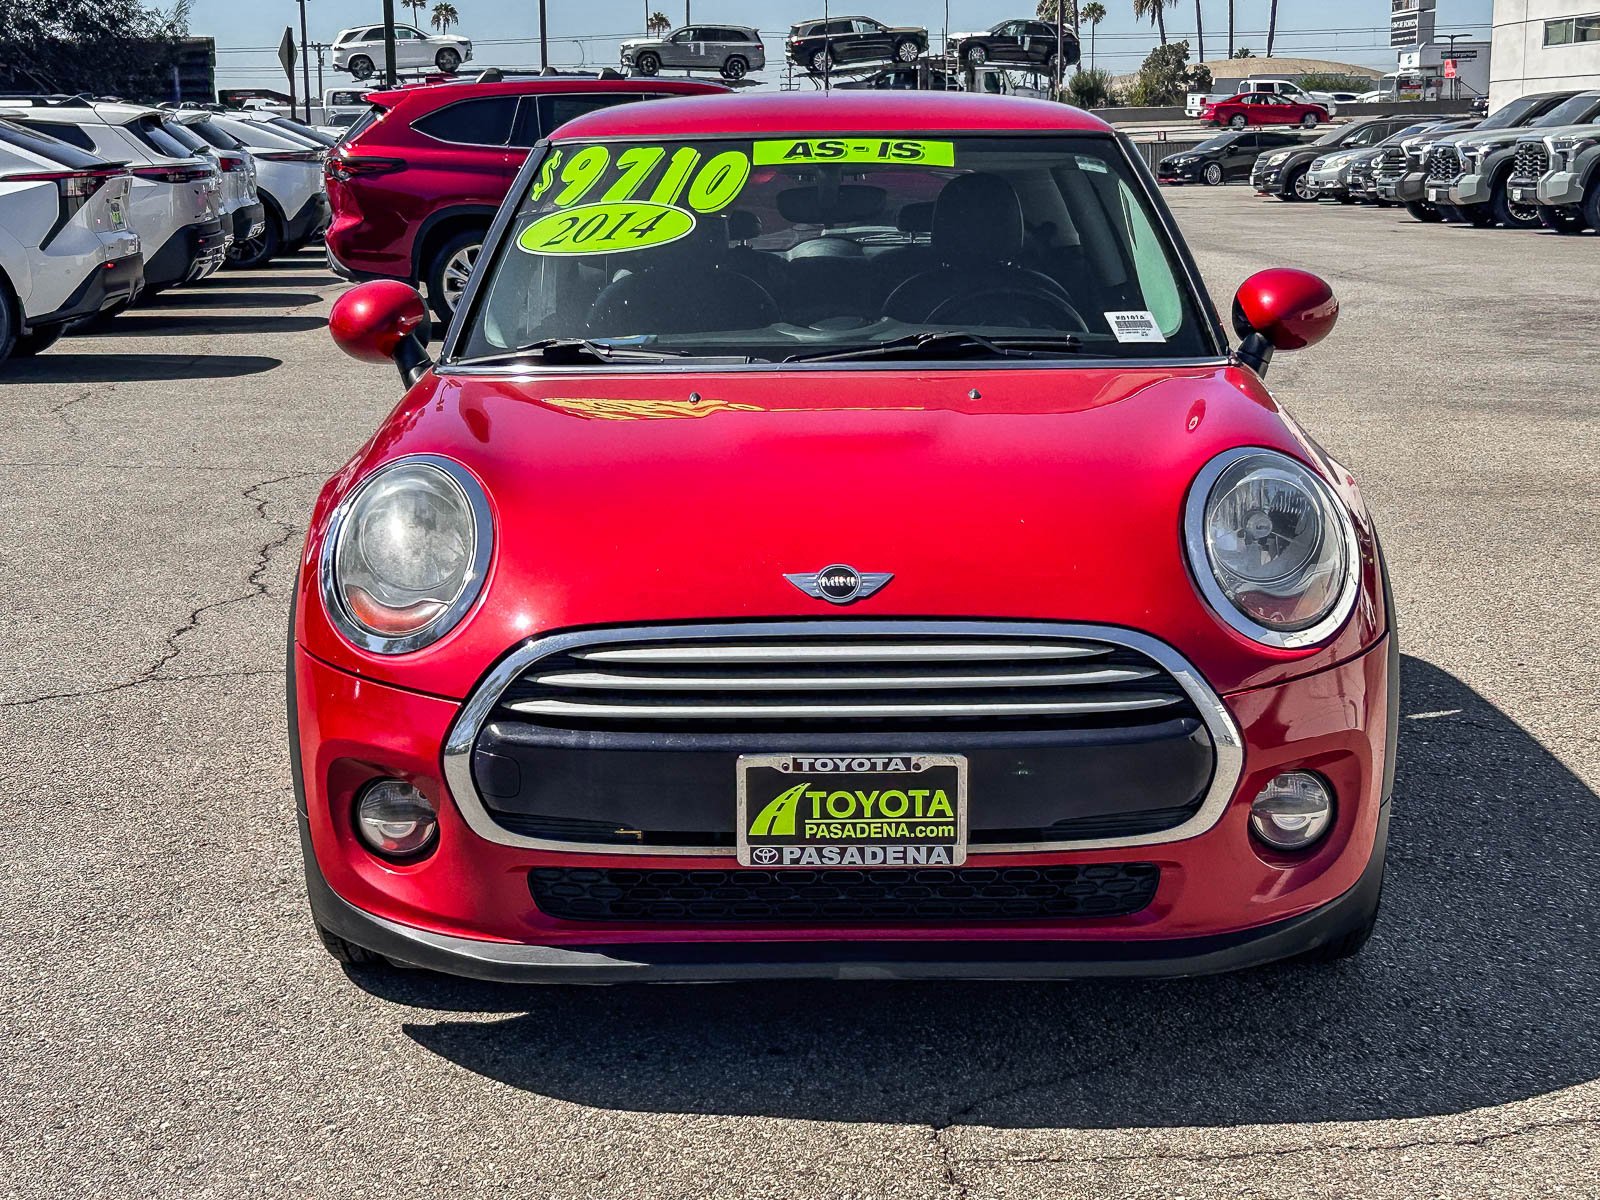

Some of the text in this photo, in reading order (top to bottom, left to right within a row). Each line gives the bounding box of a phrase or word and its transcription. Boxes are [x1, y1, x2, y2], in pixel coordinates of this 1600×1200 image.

[531, 146, 750, 213] $9710
[540, 210, 670, 247] 2014
[818, 576, 858, 587] MINI
[796, 758, 906, 772] TOYOTA
[805, 789, 954, 819] TOYOTA
[804, 823, 955, 839] PASADENA.com
[782, 846, 950, 865] PASADENA
